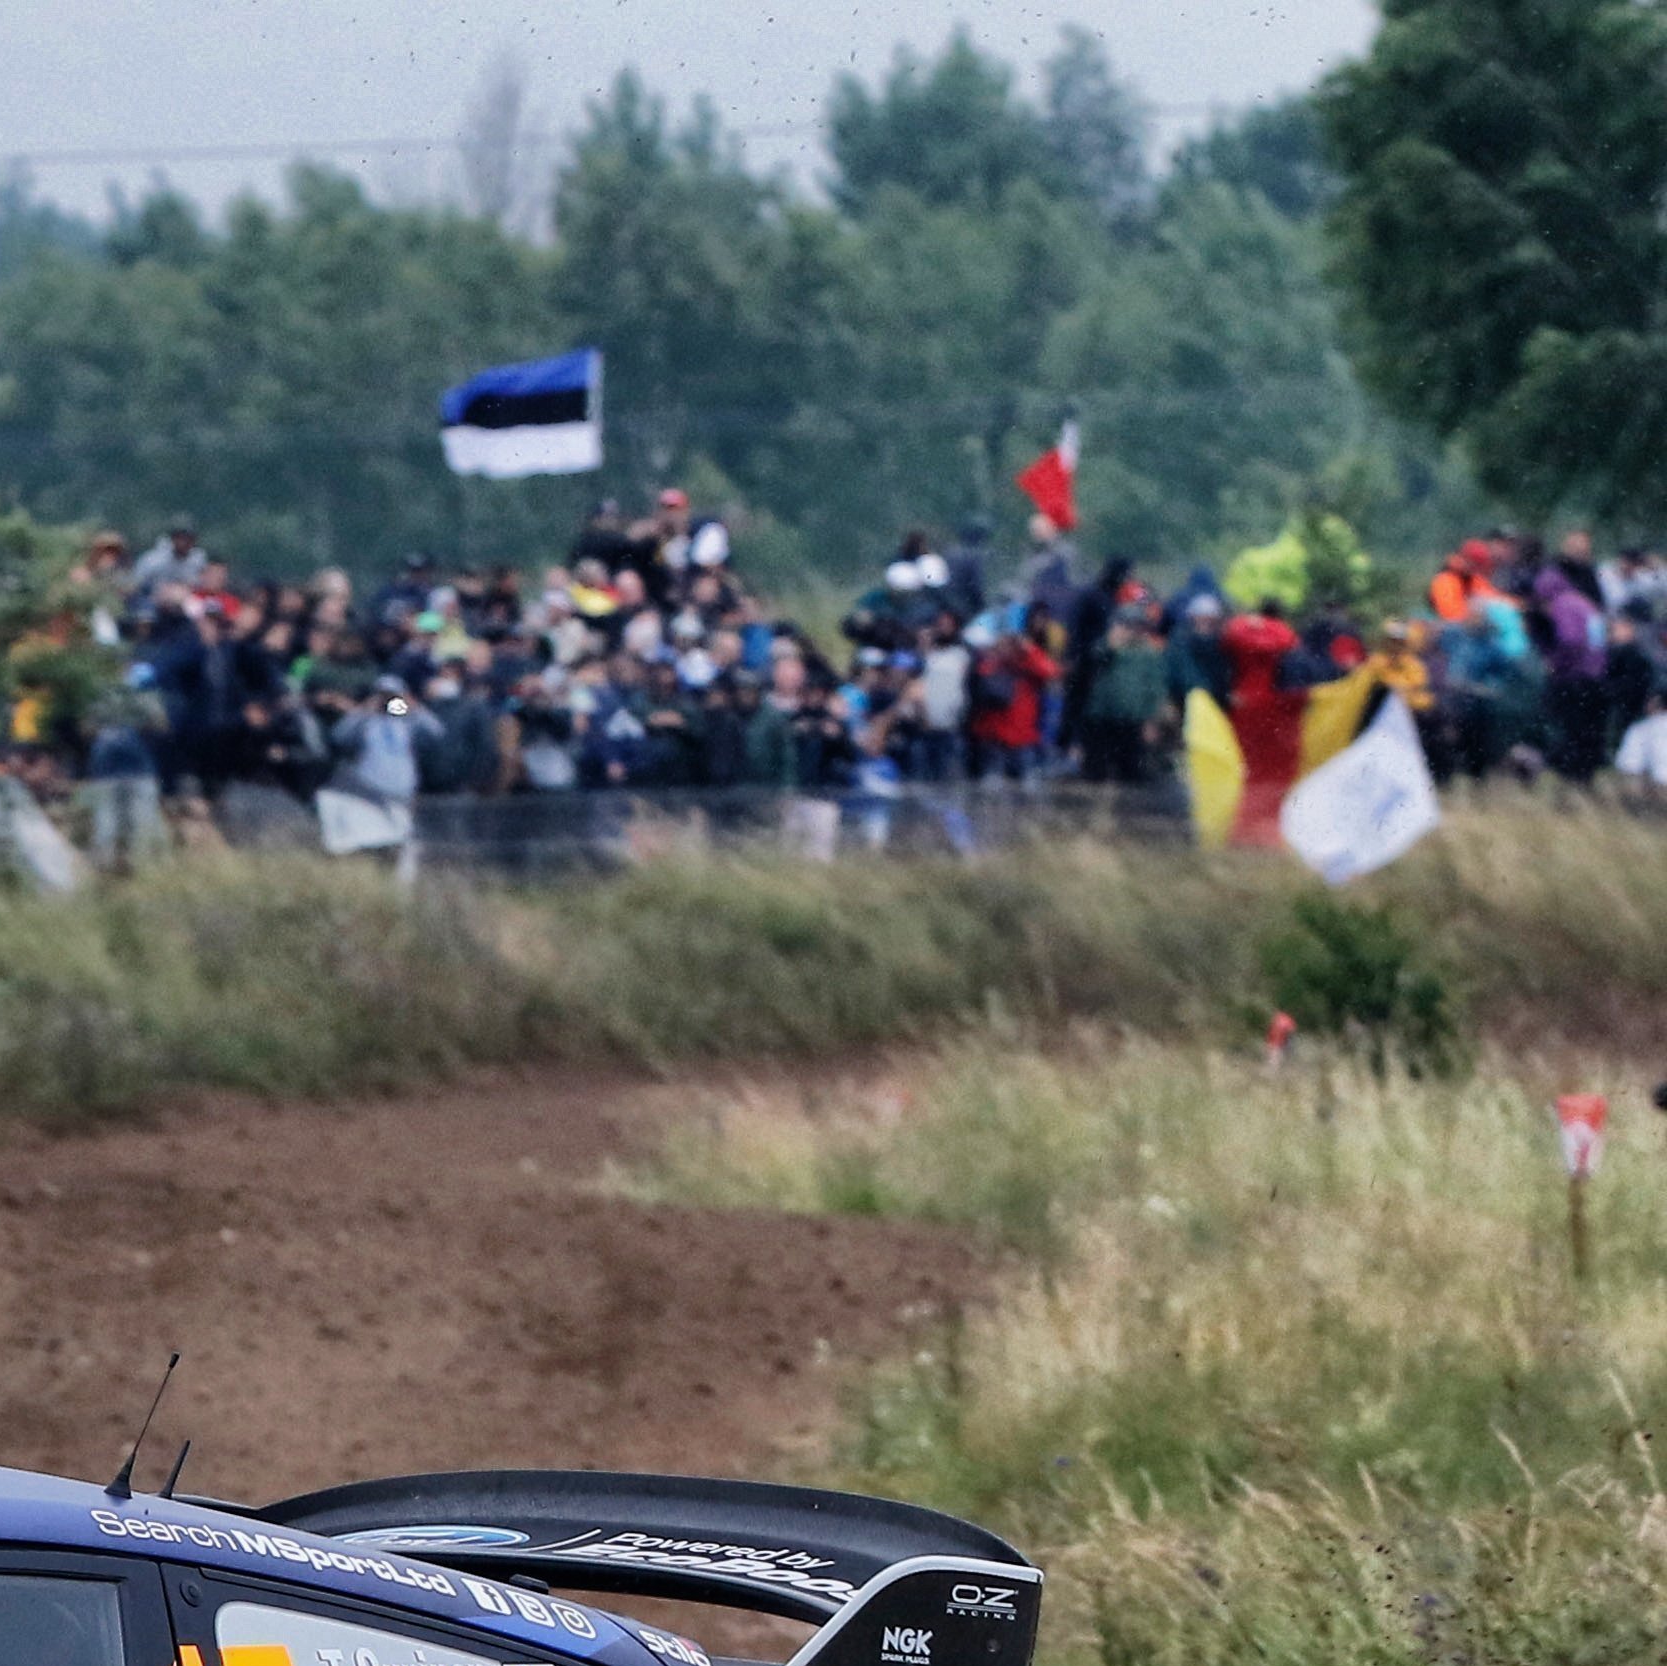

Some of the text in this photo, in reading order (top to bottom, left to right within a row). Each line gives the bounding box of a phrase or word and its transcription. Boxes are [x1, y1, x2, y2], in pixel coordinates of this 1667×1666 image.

[604, 1532, 835, 1570] Powered by
[557, 1543, 861, 1600] EcoBoo
[946, 1608, 1015, 1620] RACING
[881, 1626, 934, 1656] NGK
[881, 1653, 930, 1666] SPARK PLUGS
